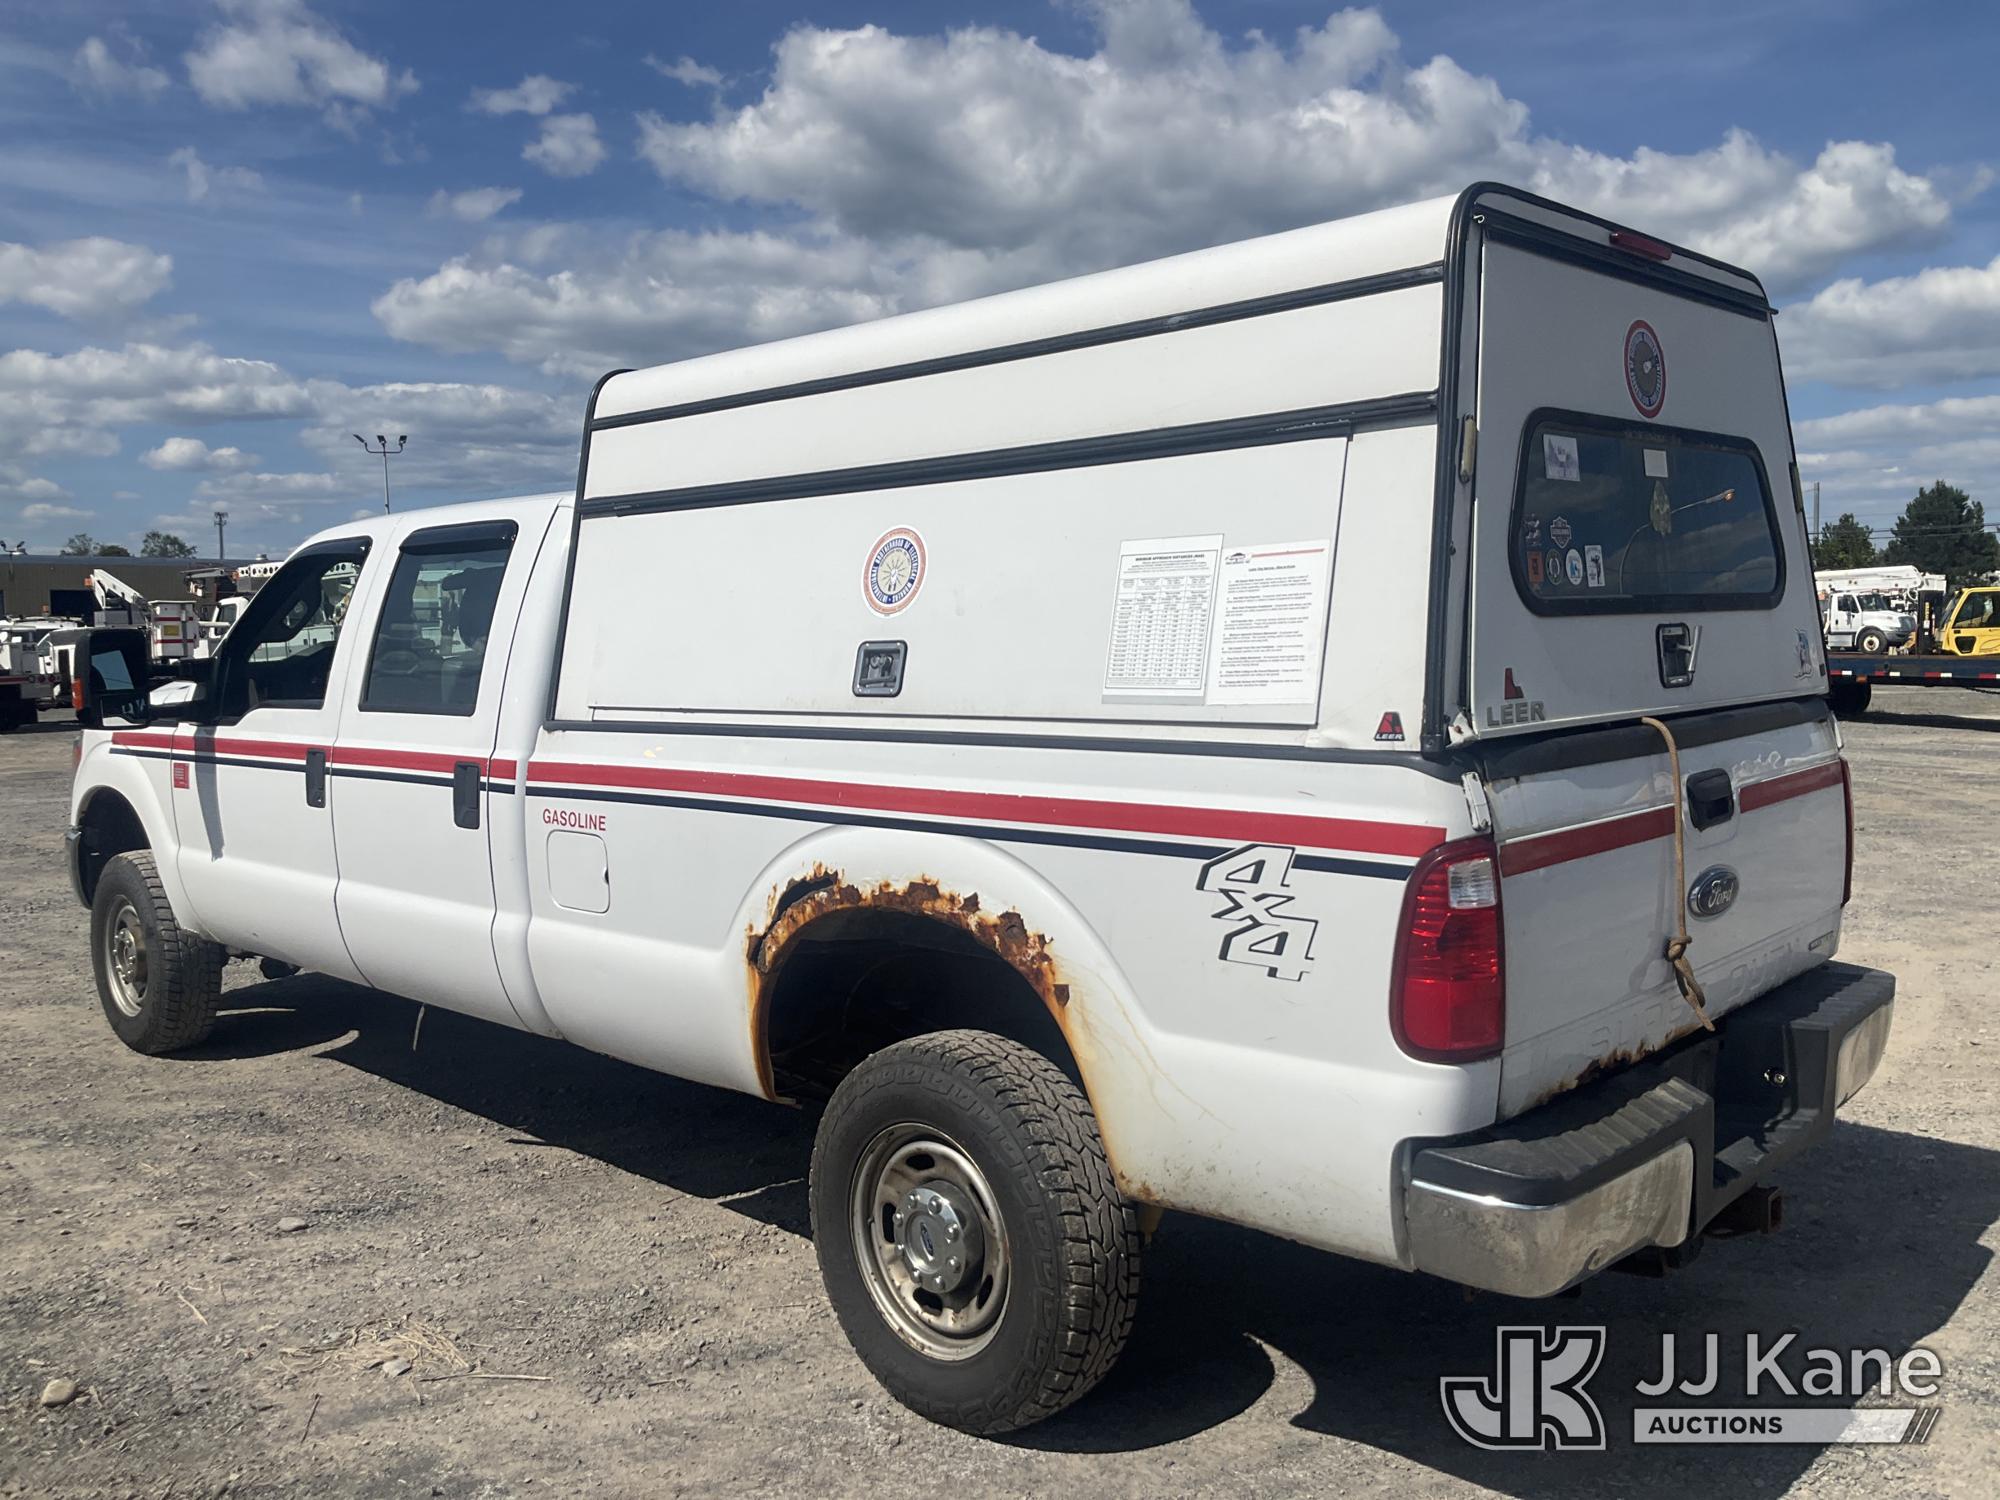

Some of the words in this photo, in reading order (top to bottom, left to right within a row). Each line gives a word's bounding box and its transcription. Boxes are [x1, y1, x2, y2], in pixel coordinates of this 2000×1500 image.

[1486, 700, 1546, 727] LEER
[1375, 733, 1404, 741] LEER
[543, 808, 606, 831] GASOLINE
[1707, 880, 1734, 908] Ford
